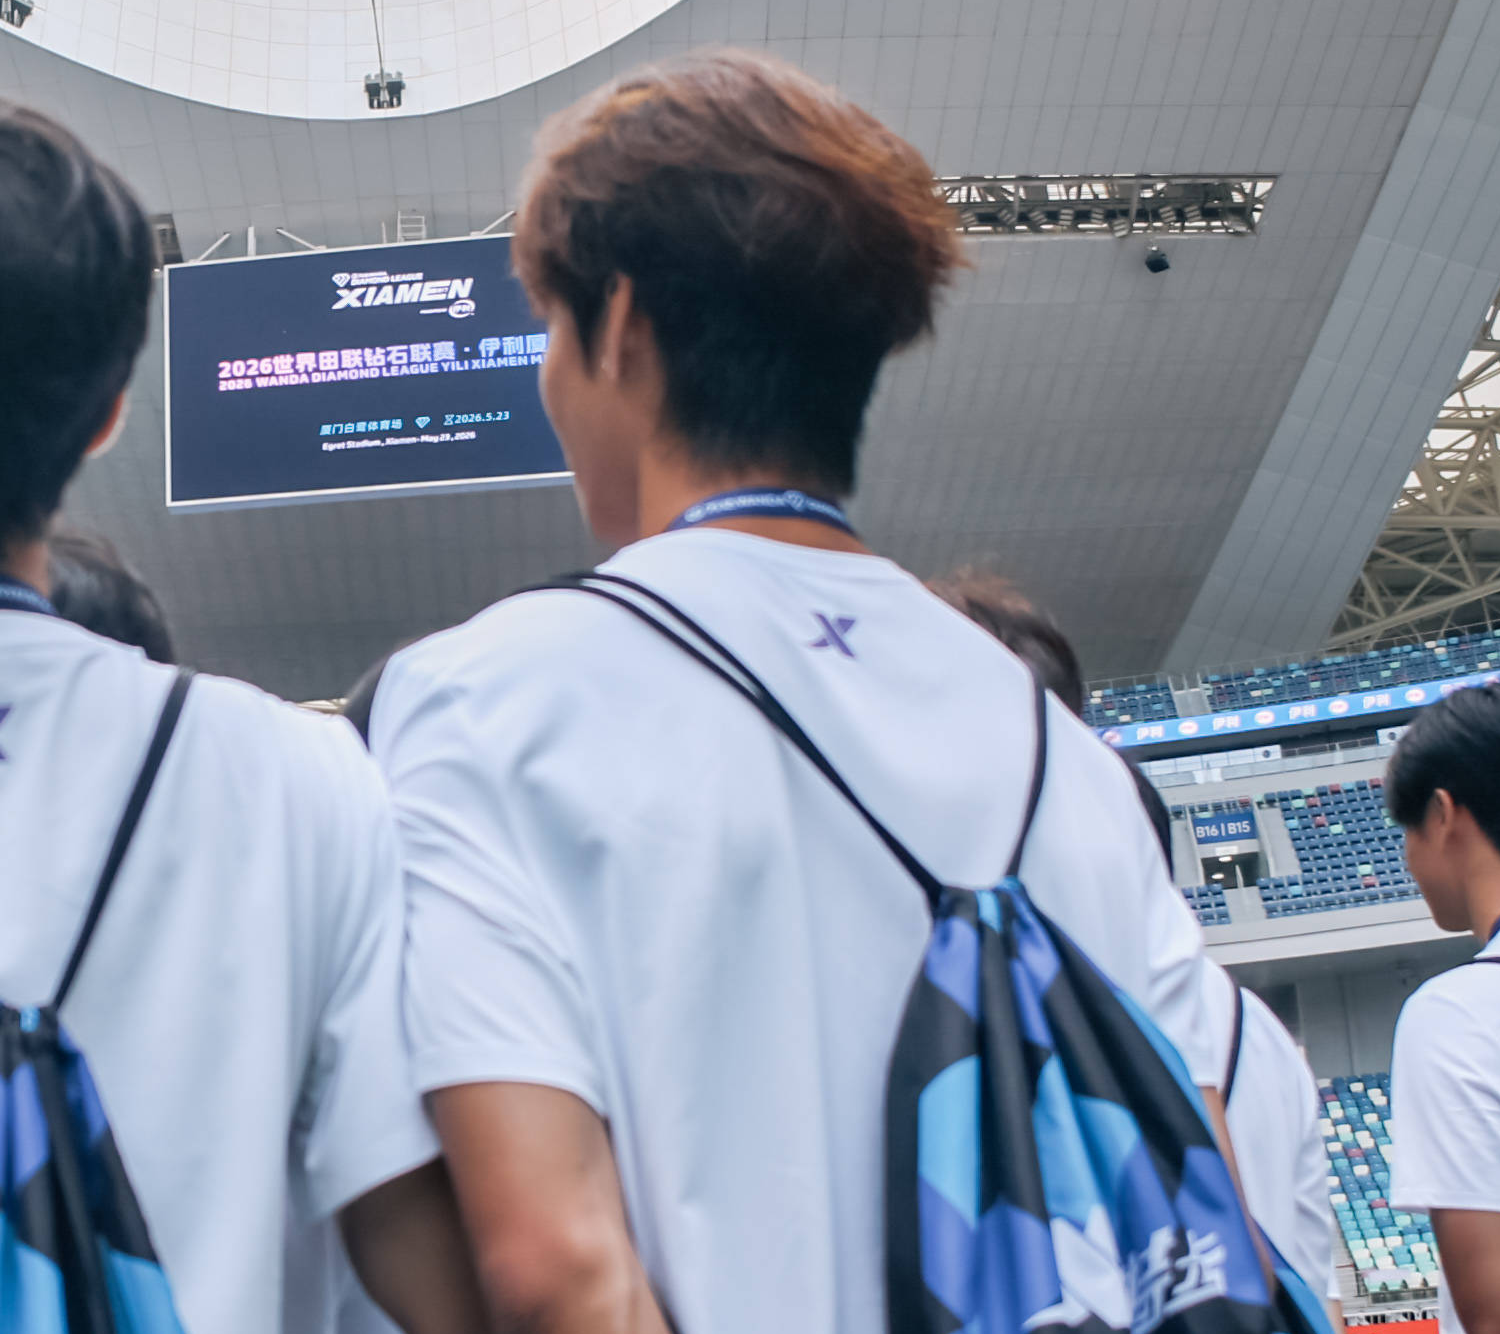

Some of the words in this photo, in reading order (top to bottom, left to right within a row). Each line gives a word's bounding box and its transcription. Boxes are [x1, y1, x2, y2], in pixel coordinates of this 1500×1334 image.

[331, 278, 474, 310] XIAMEN
[255, 373, 309, 388] WANDA
[311, 367, 380, 383] DIAMOND
[382, 363, 439, 377] LEAGUE
[441, 361, 469, 372] YILI
[471, 356, 528, 370] XIAMEN
[531, 354, 545, 365] M
[1196, 823, 1219, 839] B16
[1226, 820, 1250, 836] B15
